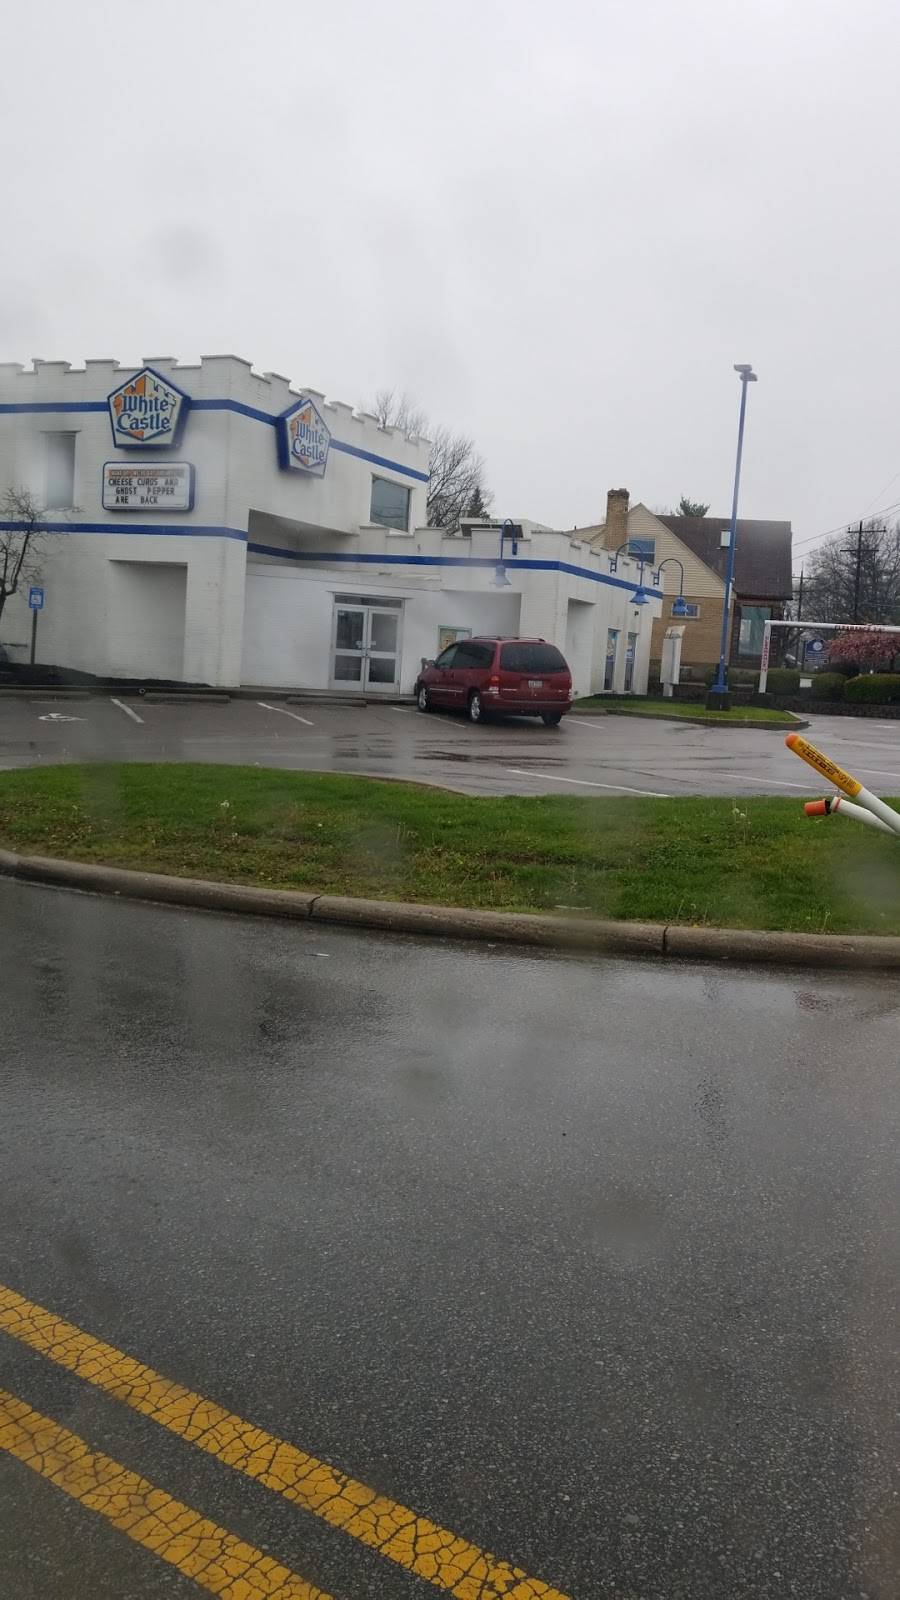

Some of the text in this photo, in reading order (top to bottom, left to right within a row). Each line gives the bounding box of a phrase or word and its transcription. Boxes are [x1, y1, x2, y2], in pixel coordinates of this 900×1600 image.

[121, 395, 169, 417] White
[117, 413, 170, 431] Castle
[295, 421, 324, 445] White
[293, 437, 325, 461] Castle
[108, 478, 133, 486] CHEESE
[137, 478, 158, 486] CURDS
[115, 486, 175, 496] GHOST PEPPER
[115, 496, 159, 504] ARE BACK
